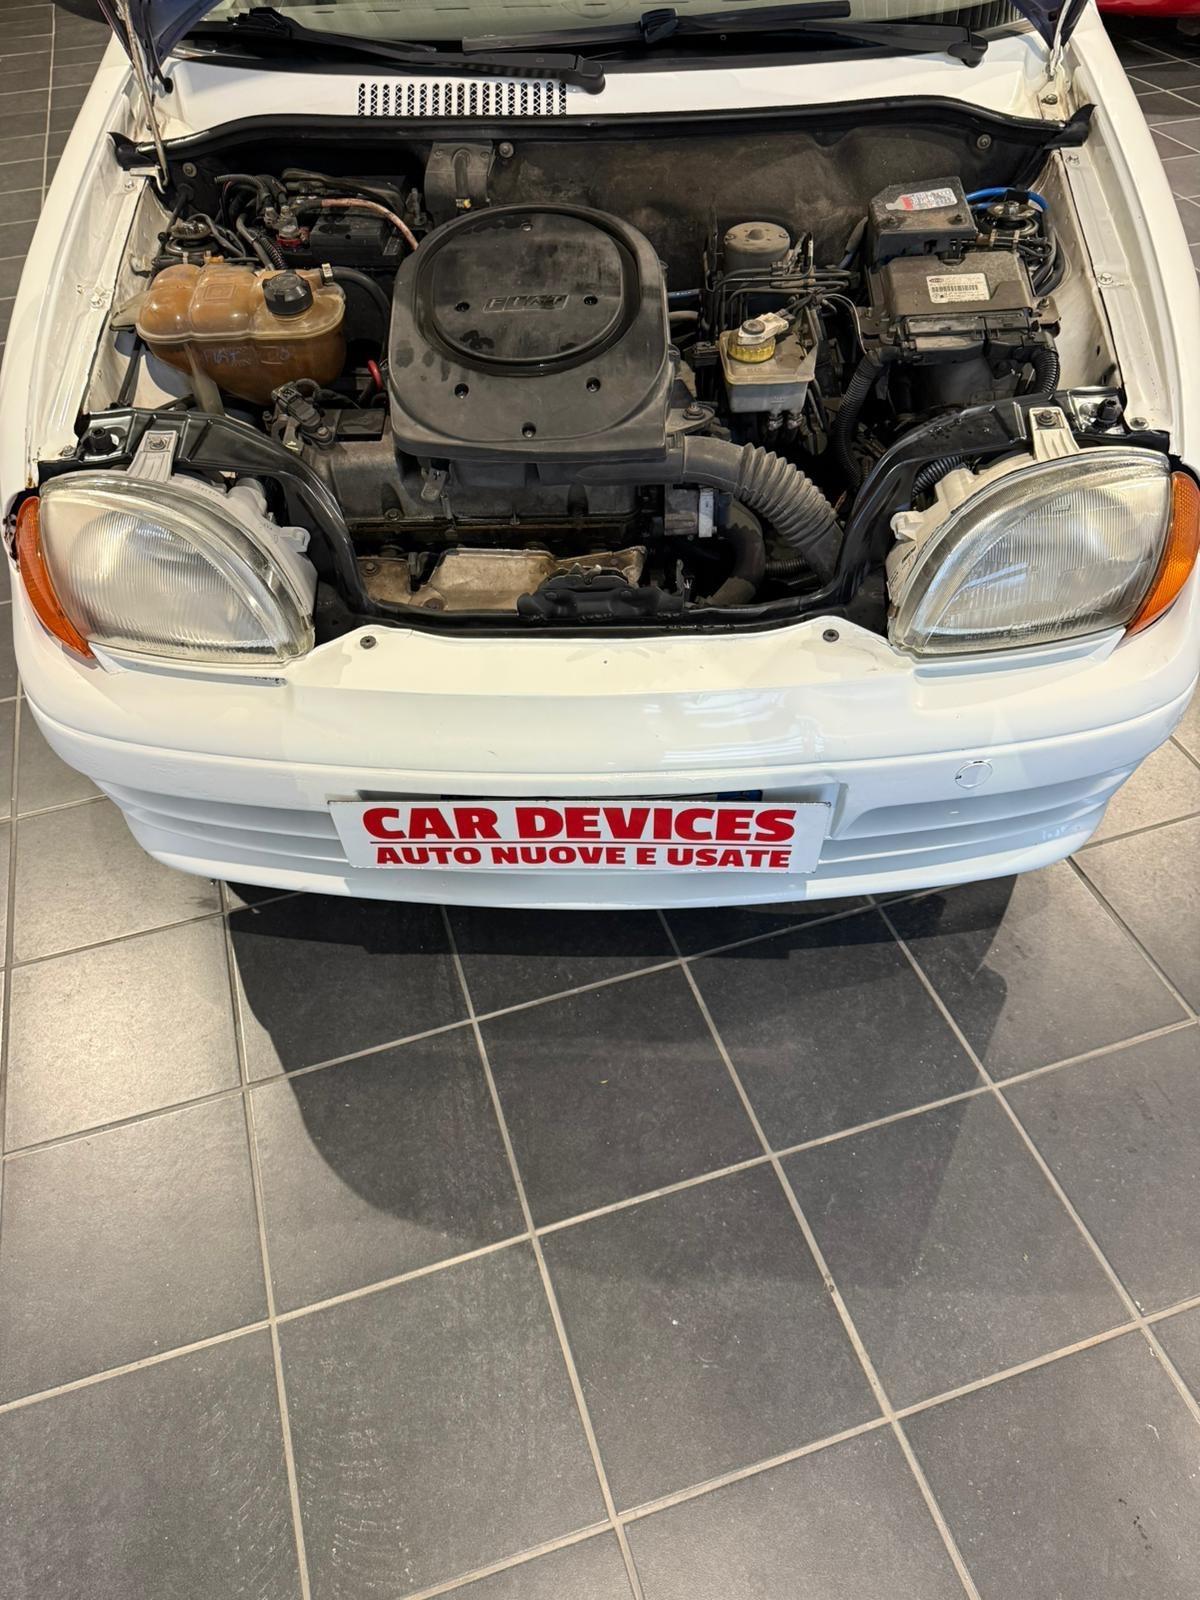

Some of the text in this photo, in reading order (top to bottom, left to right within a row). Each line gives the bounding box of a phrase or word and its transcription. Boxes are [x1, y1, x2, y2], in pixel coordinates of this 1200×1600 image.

[485, 295, 567, 311] FIAT
[363, 808, 796, 843] CAR DEVICES
[376, 845, 791, 868] AUTO NUOVE E USATE
